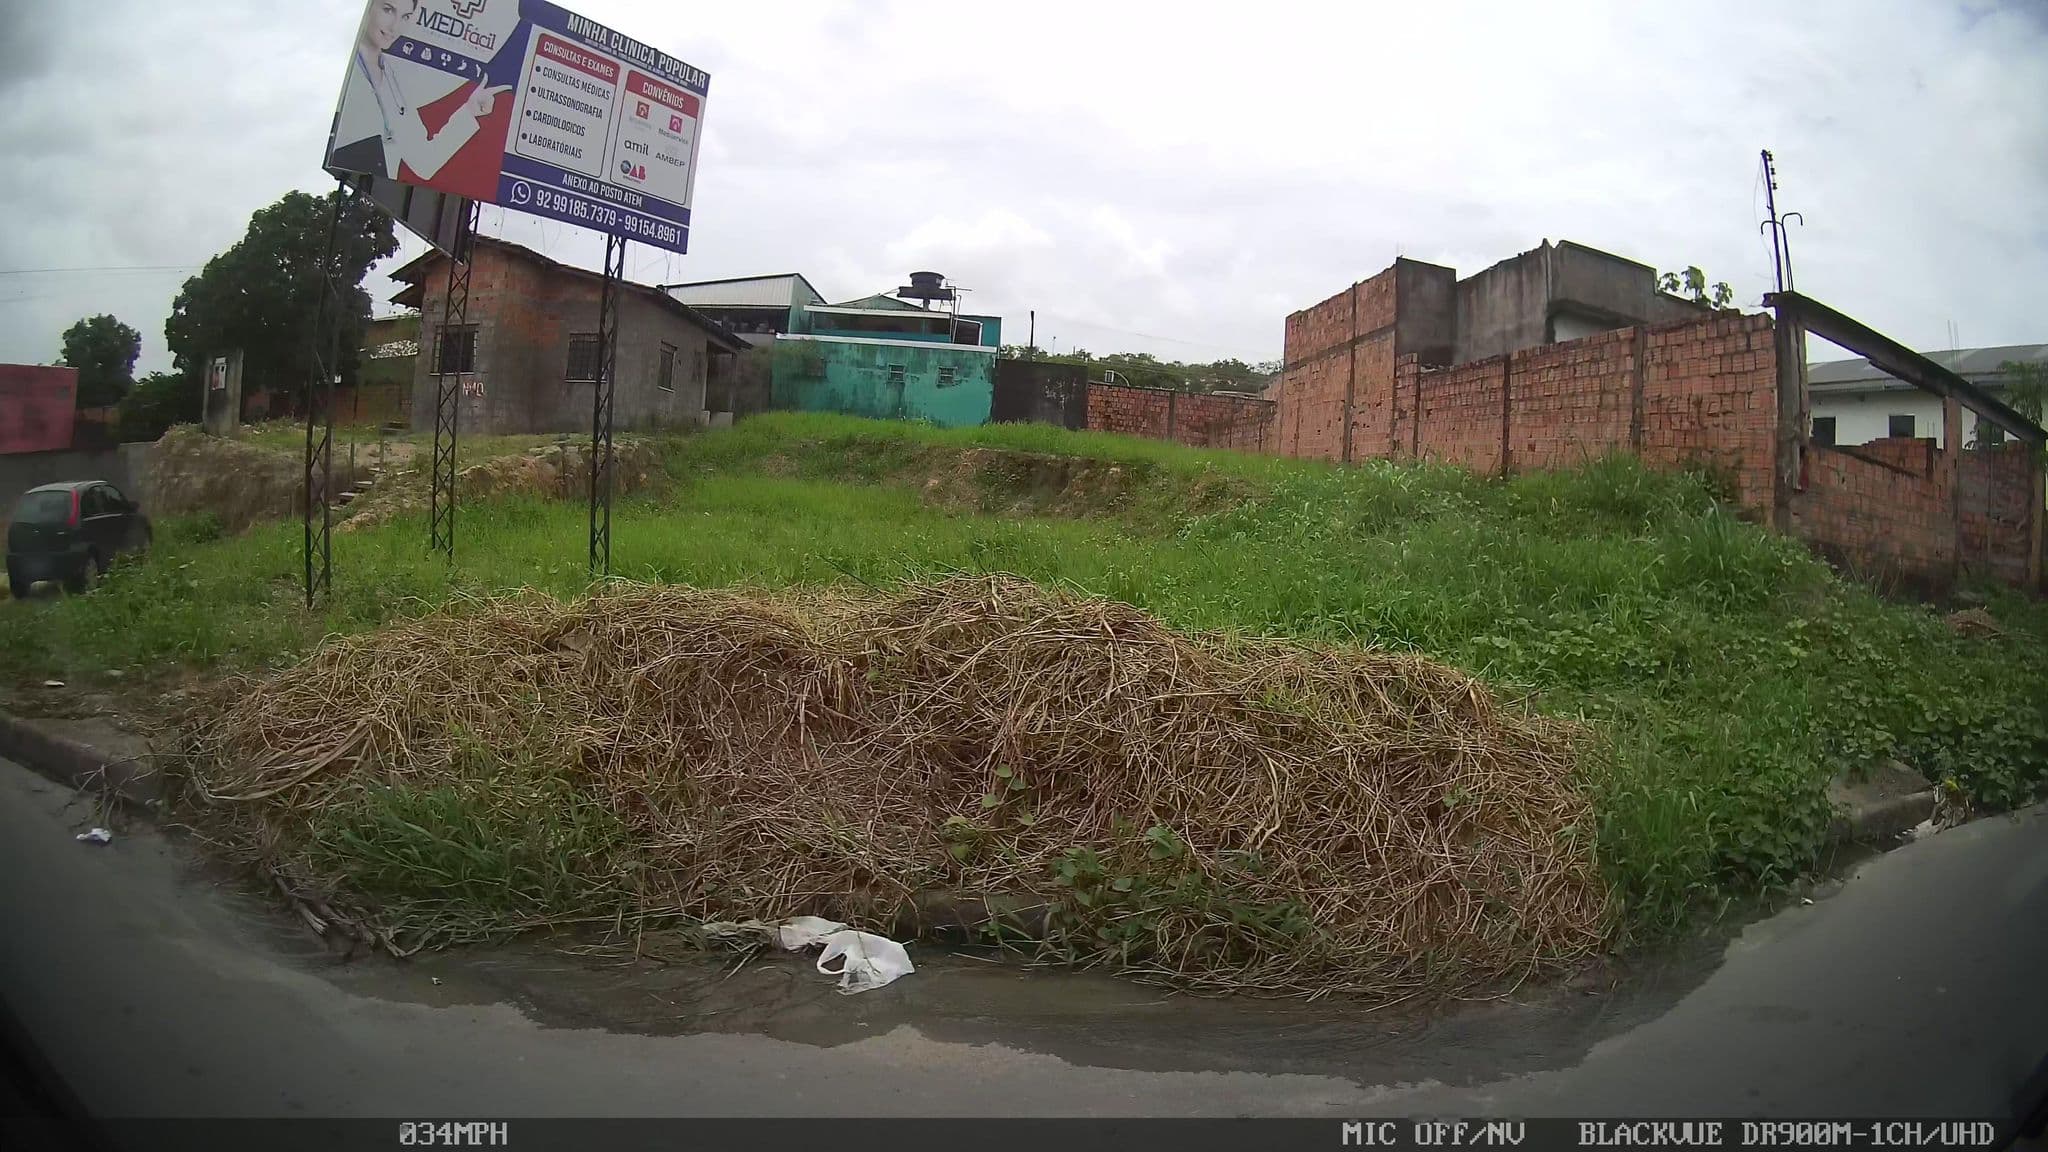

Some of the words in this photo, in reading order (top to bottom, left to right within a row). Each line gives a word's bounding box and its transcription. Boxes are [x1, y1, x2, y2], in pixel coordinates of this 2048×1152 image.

[543, 41, 581, 64] CONSULTAS
[581, 57, 587, 67] E
[587, 59, 614, 78] EXAMES
[567, 13, 607, 45] MINHA
[658, 53, 706, 89] POPULAR
[542, 66, 580, 89] CONSULTAS
[537, 86, 603, 119] ULTRASSONOGRAFIA
[624, 140, 649, 156] amil
[562, 173, 588, 191] ANEXO
[588, 181, 599, 194] AO
[600, 184, 624, 201] POSTO
[623, 192, 642, 207] ATEM
[536, 189, 551, 209] 92
[552, 195, 617, 227] 99185.7379
[624, 214, 681, 245] 99154.8961
